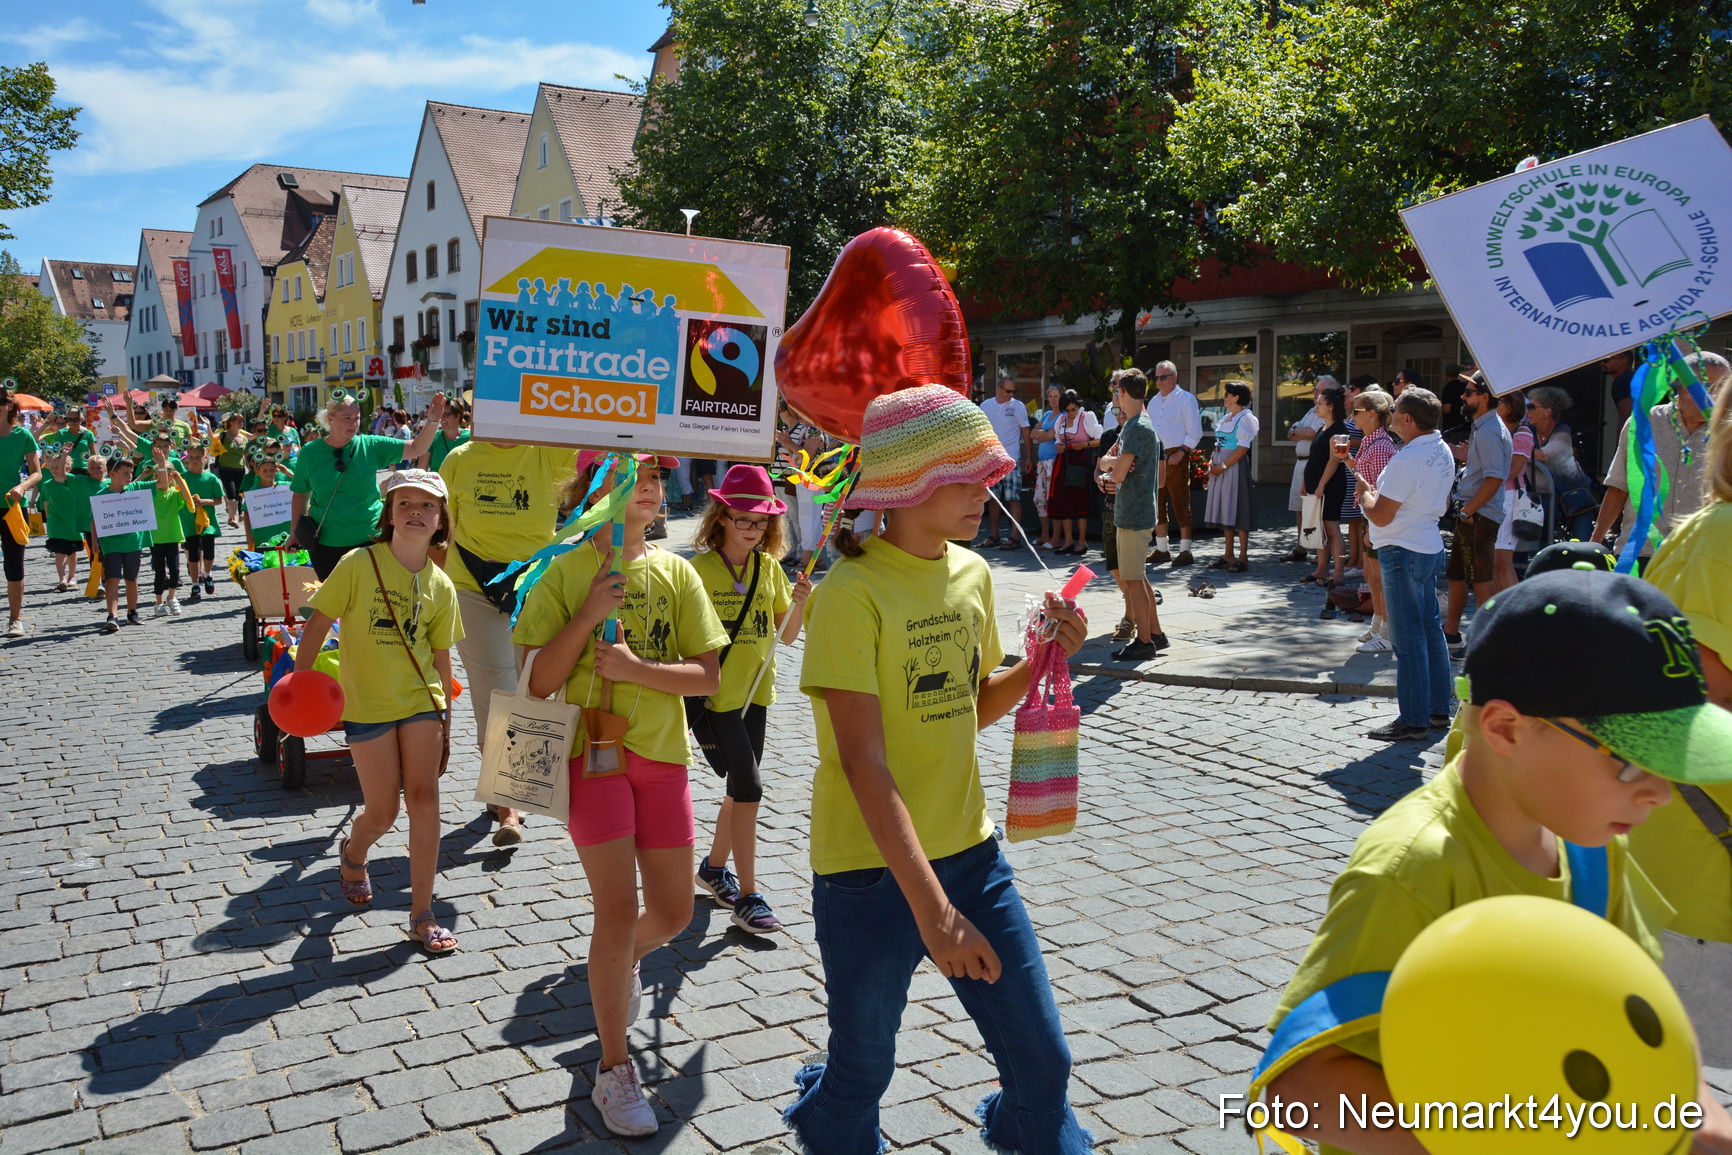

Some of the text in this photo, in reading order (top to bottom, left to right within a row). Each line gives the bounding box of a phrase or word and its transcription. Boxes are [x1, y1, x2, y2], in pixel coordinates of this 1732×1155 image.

[1486, 163, 1692, 269] UMWELTSCHULE IN EUROPA
[217, 252, 229, 275] K&L
[1494, 209, 1719, 337] INTERNATIONALE AGENDA 21-SCHULE
[290, 315, 304, 327] HOTEL
[487, 307, 611, 340] Wir sind
[483, 335, 671, 380] Fairtrade
[530, 381, 648, 418] School
[685, 399, 757, 417] FAIRTRADE
[692, 423, 711, 431] Siegel
[117, 509, 143, 517] Frösche
[906, 610, 962, 632] Grundschule
[908, 631, 952, 649] Holzheim
